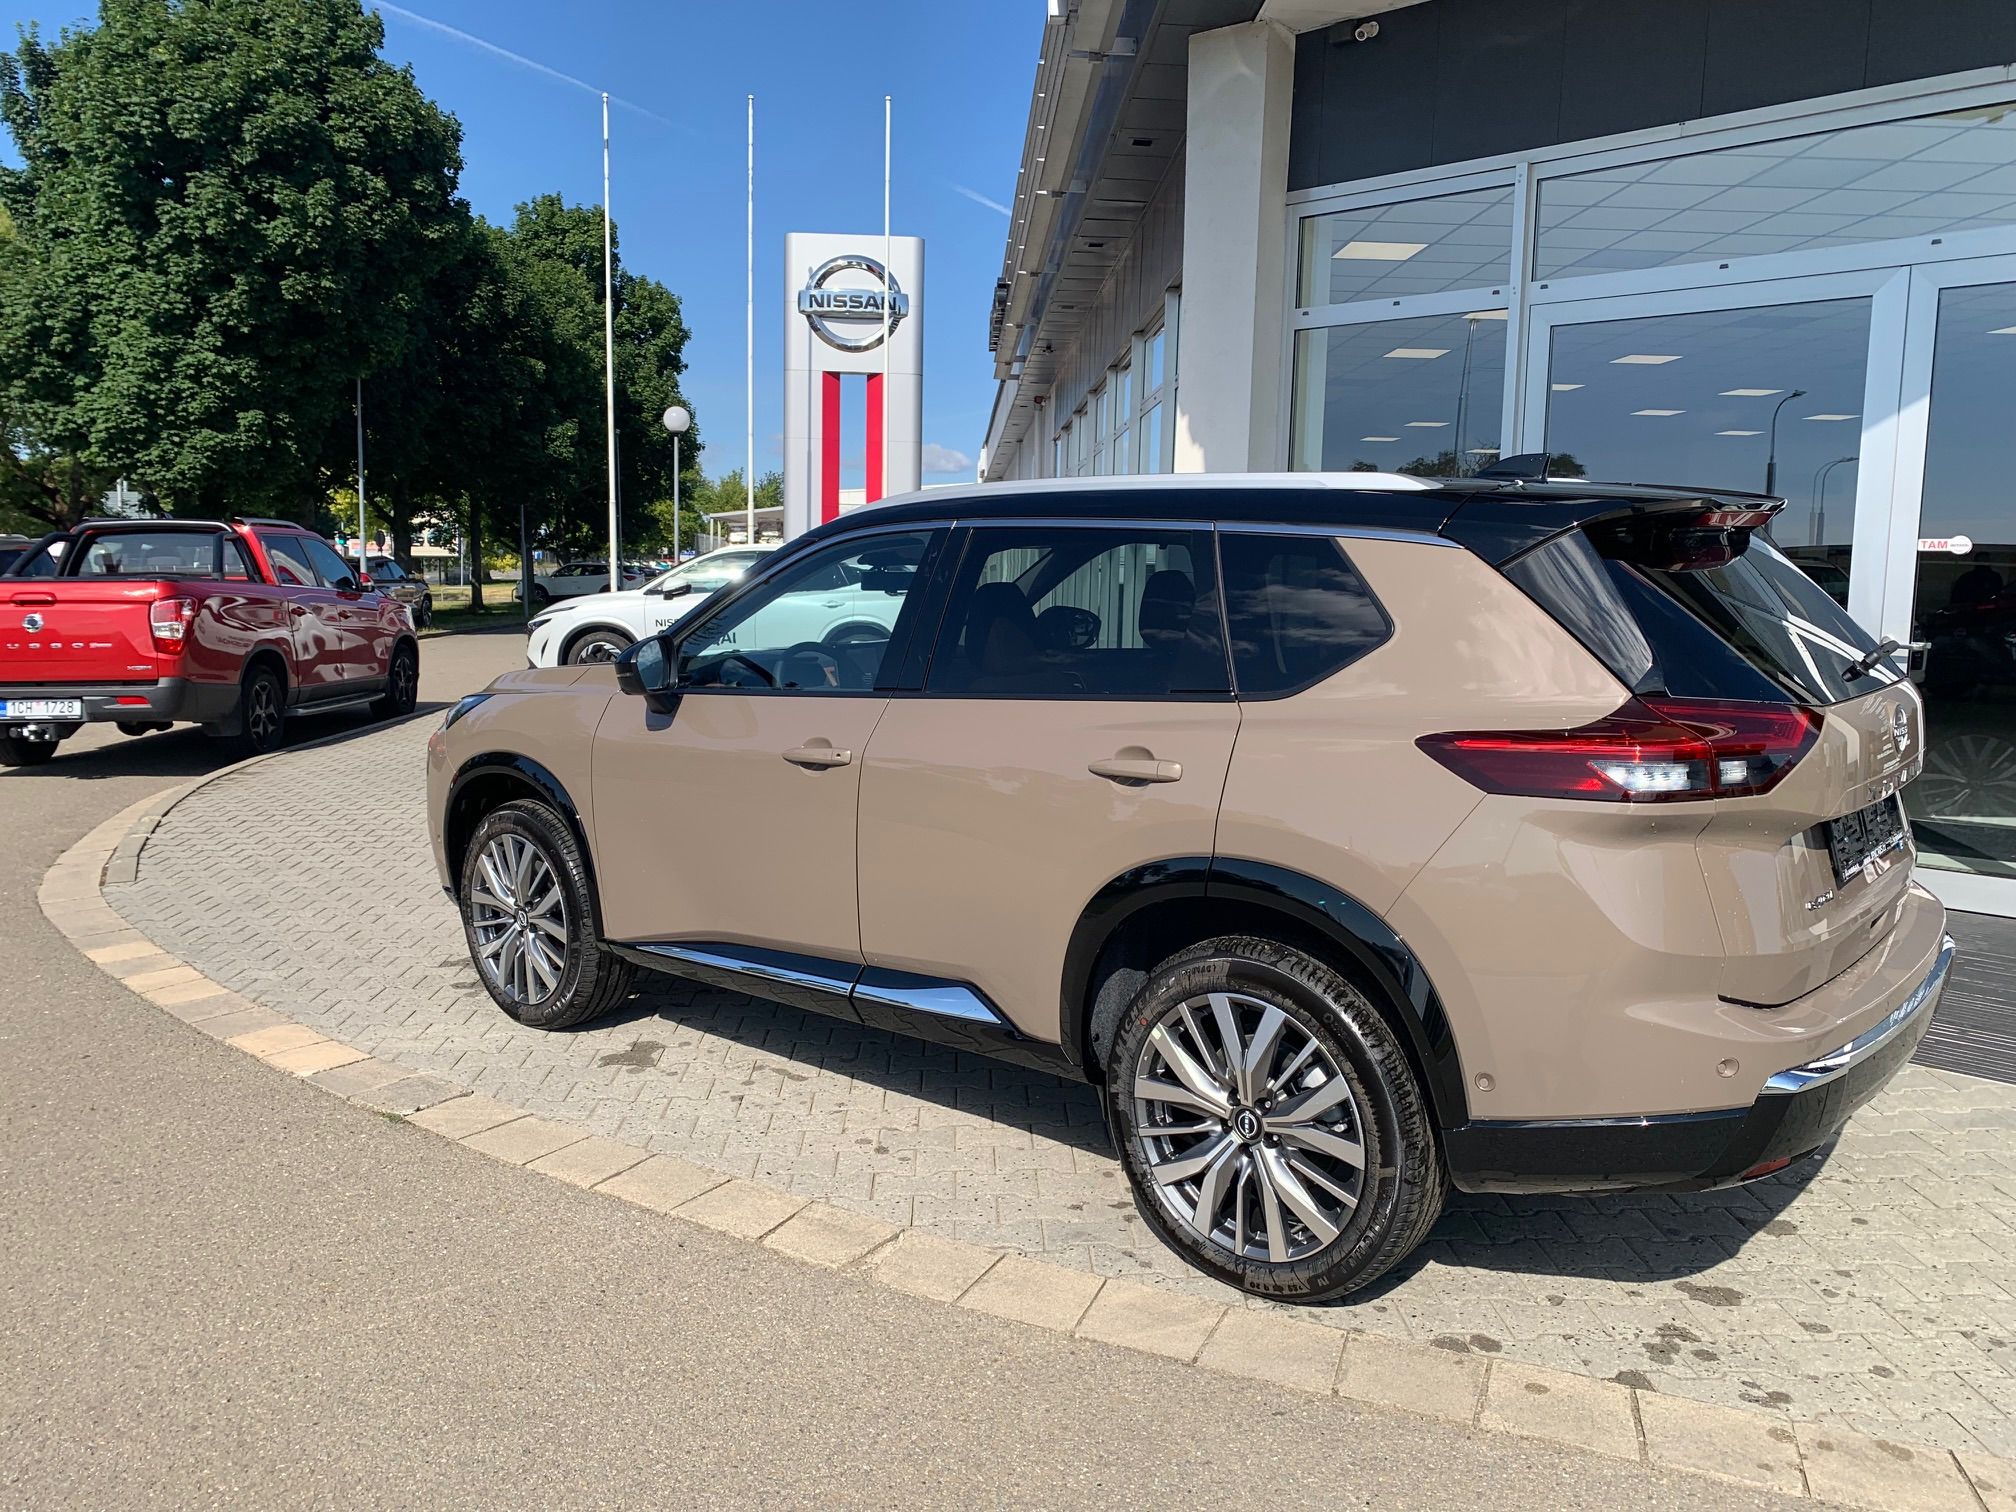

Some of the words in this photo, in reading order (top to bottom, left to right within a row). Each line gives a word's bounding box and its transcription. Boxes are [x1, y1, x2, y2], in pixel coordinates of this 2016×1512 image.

[809, 294, 897, 311] NISSAN
[1920, 540, 1948, 549] TAM
[11, 702, 33, 714] 1CH
[44, 702, 74, 714] 1728
